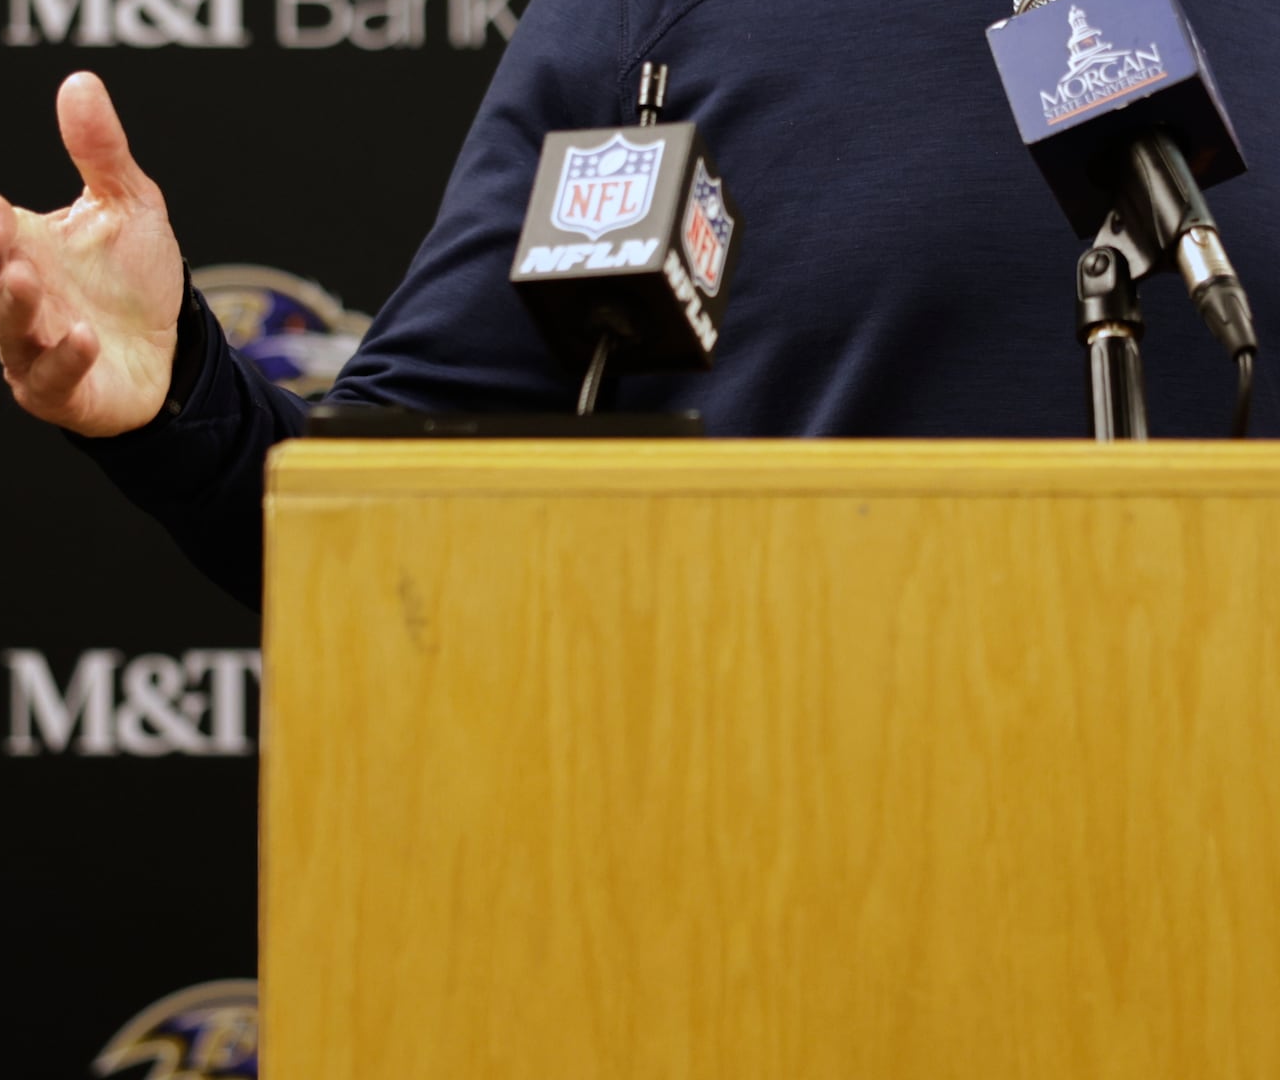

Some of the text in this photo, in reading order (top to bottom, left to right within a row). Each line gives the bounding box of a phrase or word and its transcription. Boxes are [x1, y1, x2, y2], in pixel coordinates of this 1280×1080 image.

[1040, 42, 1161, 111] MORGAN
[566, 180, 638, 222] NFL
[519, 237, 660, 274] NFLN
[686, 201, 718, 282] NFL
